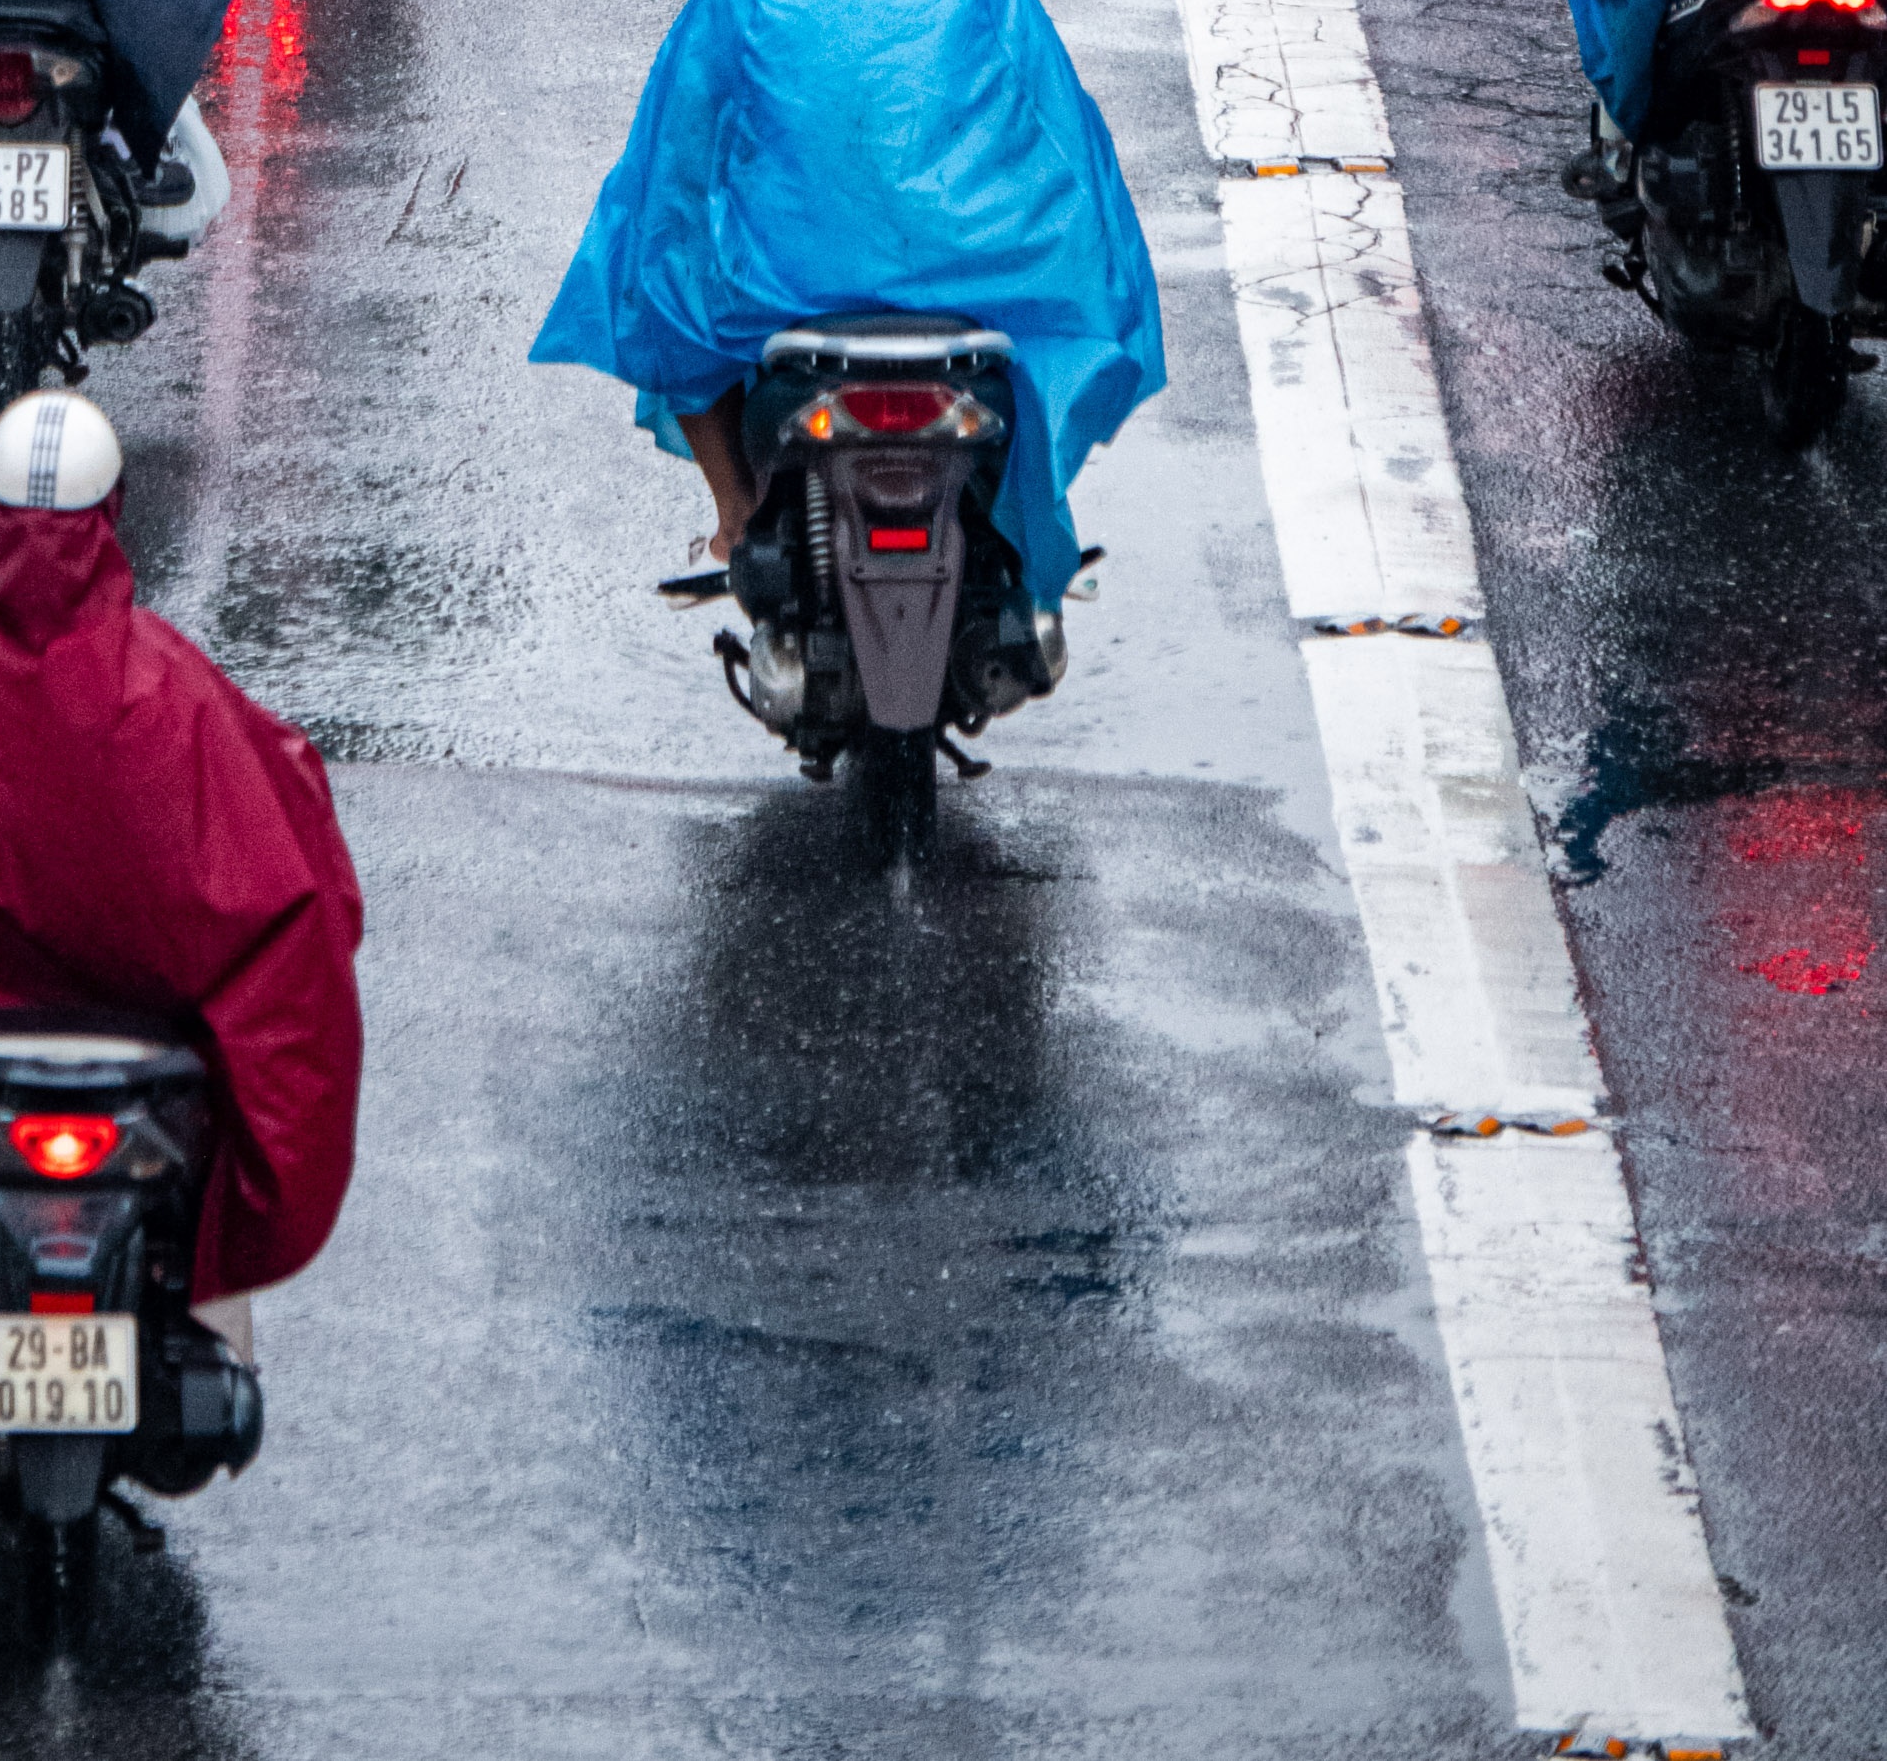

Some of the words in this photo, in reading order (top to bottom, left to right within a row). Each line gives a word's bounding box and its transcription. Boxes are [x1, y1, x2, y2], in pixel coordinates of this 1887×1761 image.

[1774, 90, 1861, 125] 29-L5
[1767, 128, 1874, 163] 341.65
[7, 1325, 110, 1372] 29-BA
